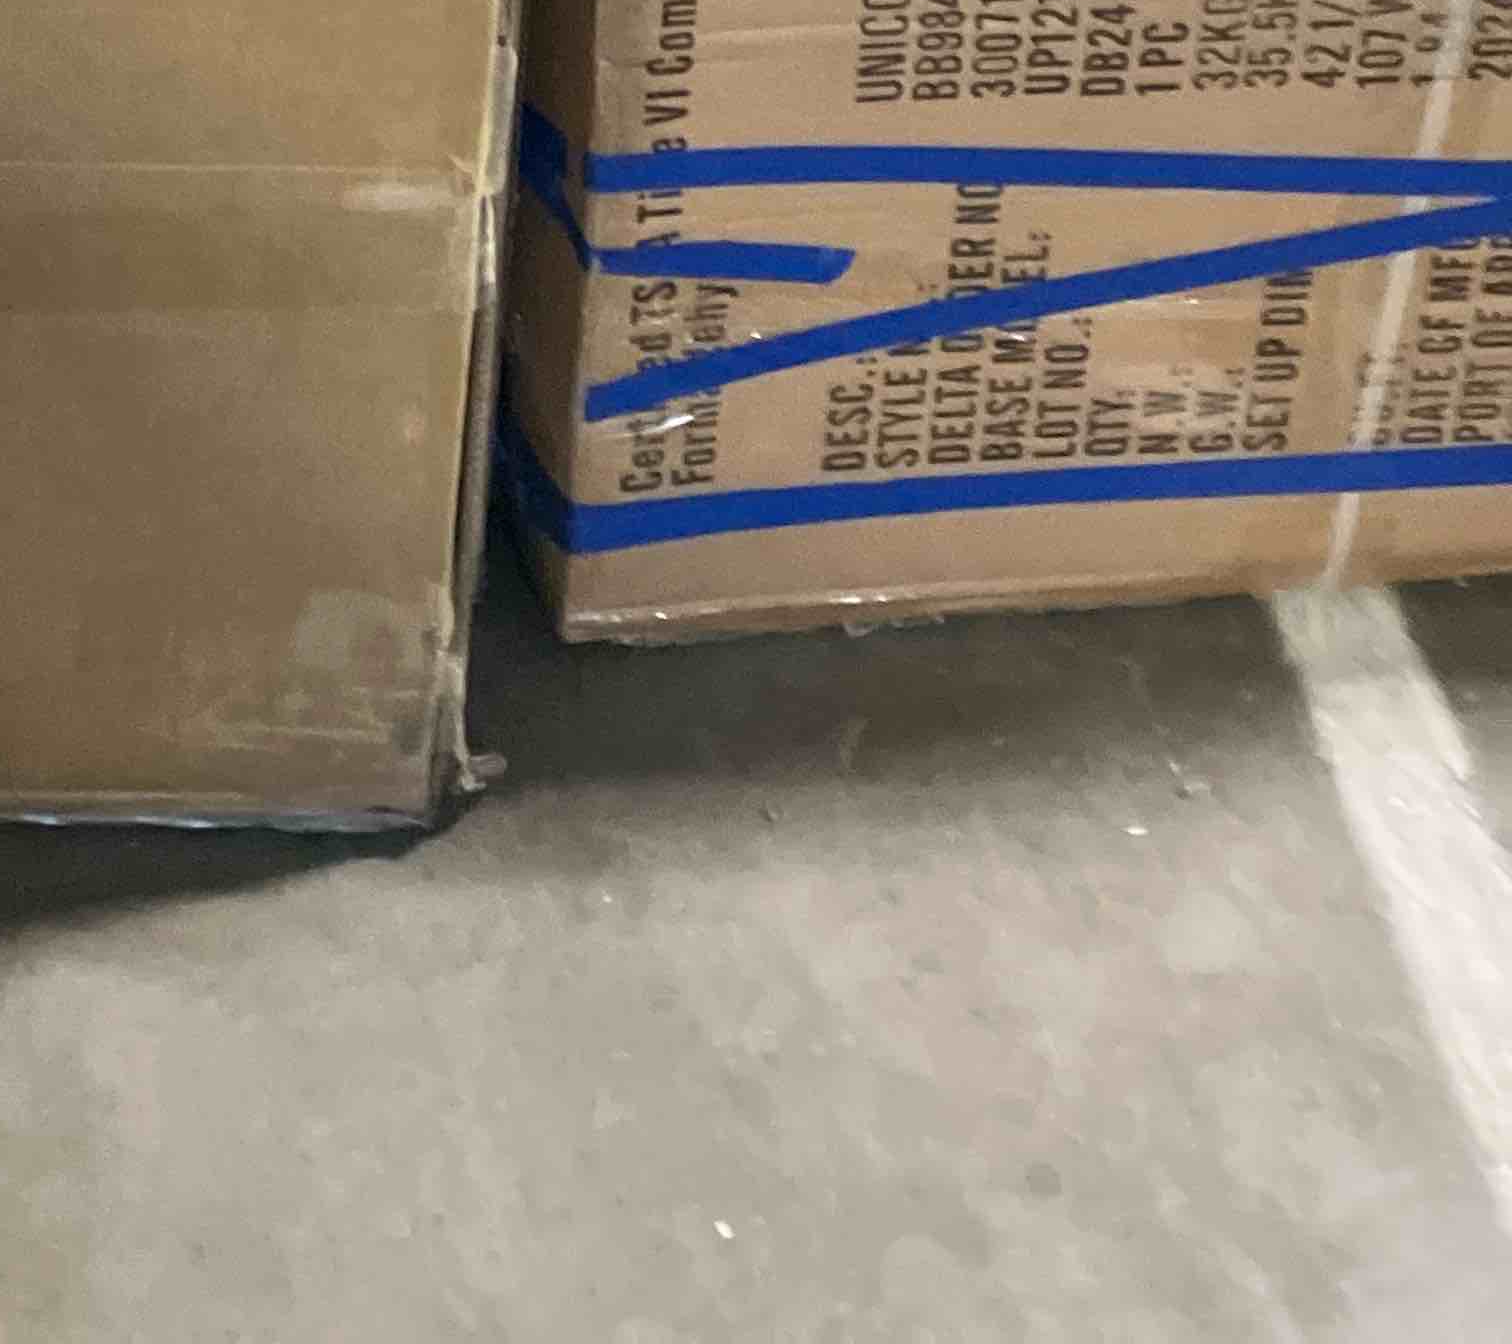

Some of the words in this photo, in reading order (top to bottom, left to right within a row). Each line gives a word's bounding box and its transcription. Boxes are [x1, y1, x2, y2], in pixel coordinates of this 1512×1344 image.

[1138, 22, 1189, 68] PC
[1300, 44, 1352, 89] 42
[1355, 28, 1406, 90] 107
[643, 90, 692, 127] VI
[1134, 82, 1181, 96] 1
[635, 136, 687, 224] Tie
[629, 231, 681, 326] TSA
[1251, 337, 1303, 383] UP
[873, 368, 928, 468] STYLE
[927, 364, 982, 465] DELTA
[980, 358, 1034, 461] BASE
[1031, 401, 1082, 459] LOT
[1241, 392, 1294, 452] SET
[1399, 365, 1460, 445] DATE
